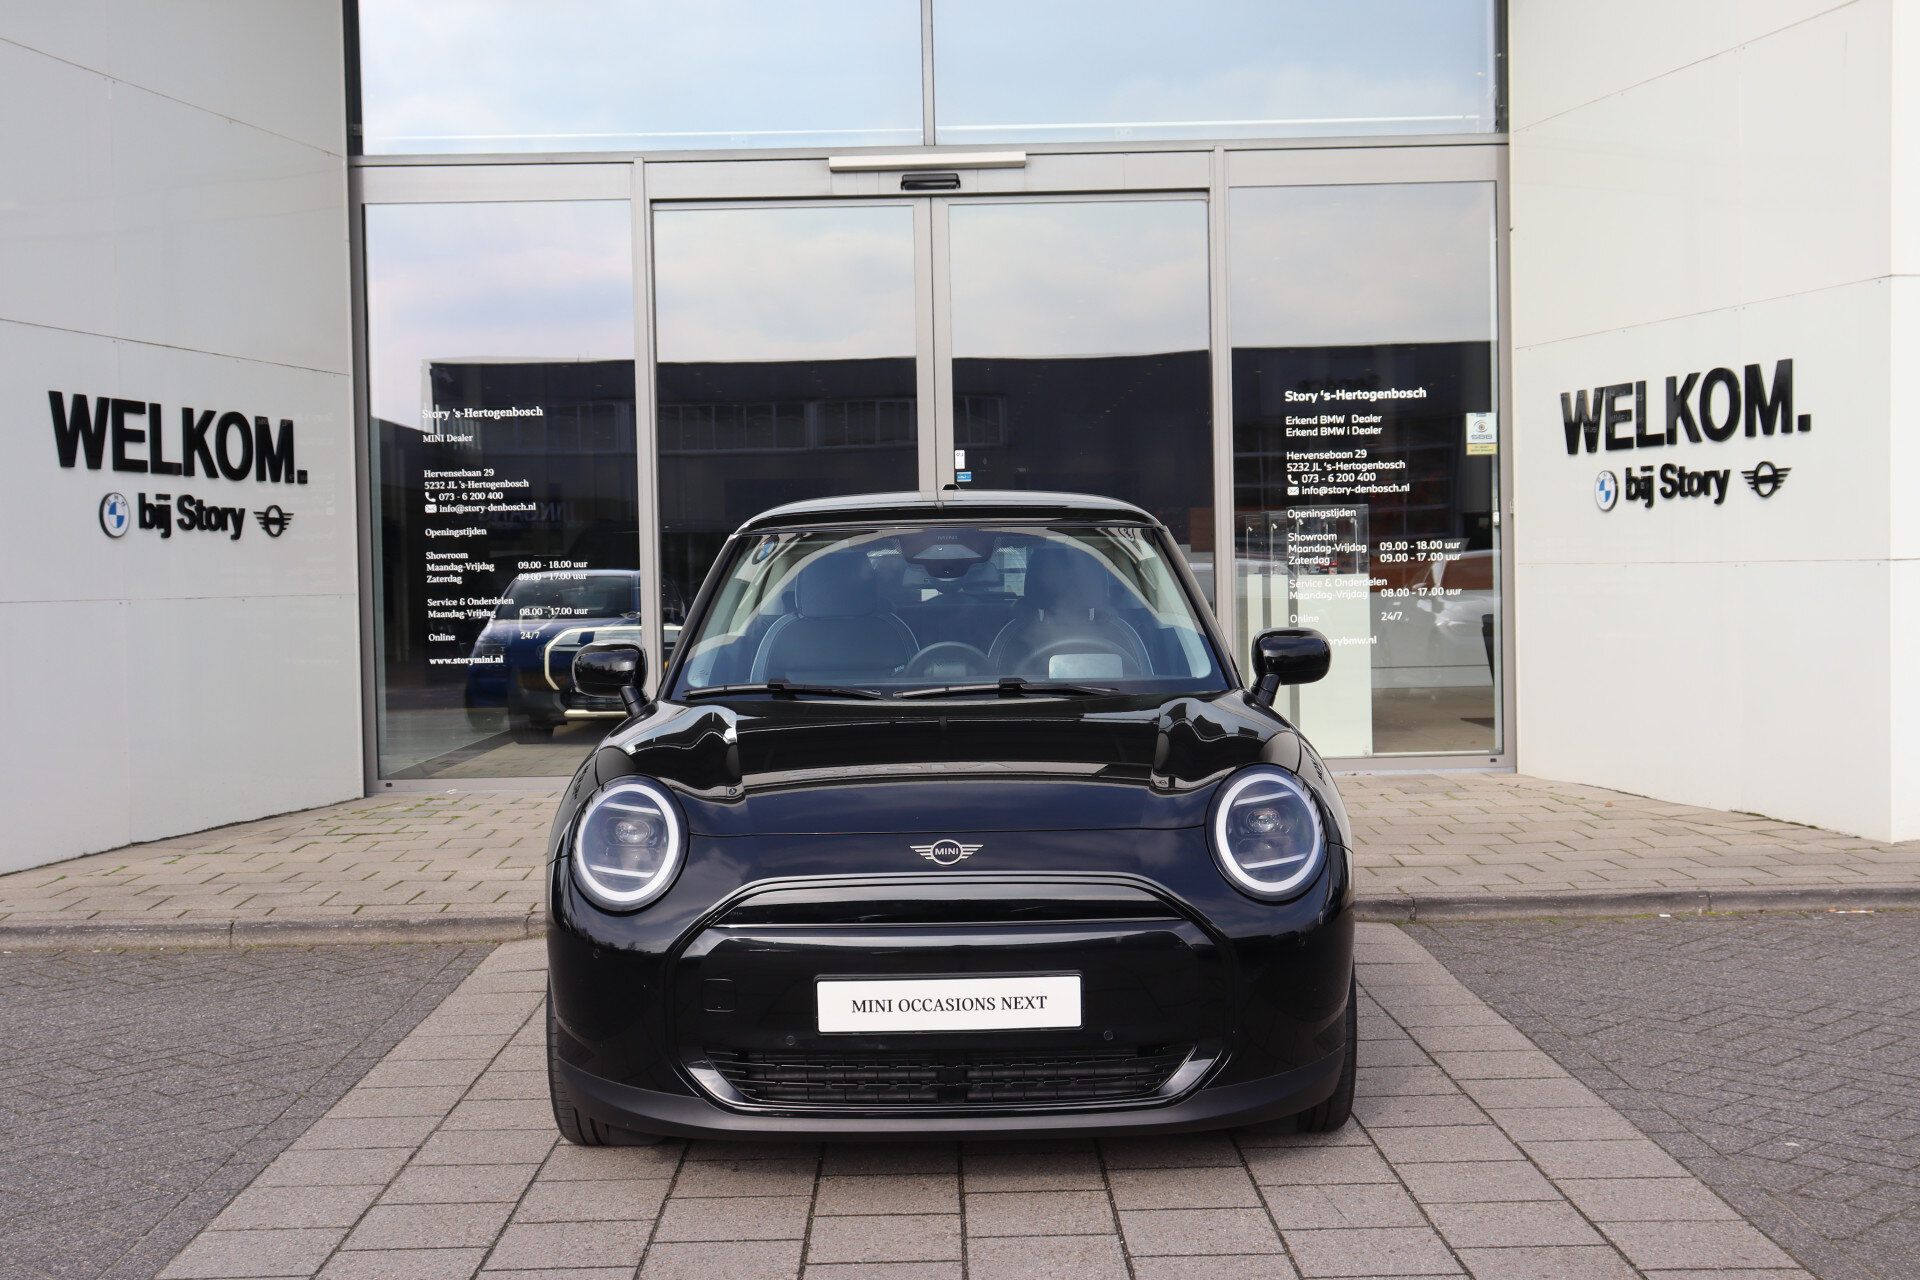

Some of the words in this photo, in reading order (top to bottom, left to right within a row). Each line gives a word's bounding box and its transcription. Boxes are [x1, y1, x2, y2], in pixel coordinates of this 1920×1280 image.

[1284, 390, 1318, 403] Story
[1560, 358, 1811, 455] WELKOM.
[422, 408, 450, 420] Story
[1285, 416, 1318, 425] Erkend
[1320, 415, 1345, 424] BMW
[1352, 414, 1382, 423] Dealer
[1286, 427, 1318, 437] Erkend
[1320, 426, 1345, 436] BMW
[1352, 426, 1382, 435] Dealer
[48, 390, 308, 484] WELKOM.
[422, 434, 444, 442] MINI
[446, 434, 473, 442] Dealer
[1286, 450, 1353, 460] Hervensebaan
[1354, 450, 1367, 459] 29
[1287, 462, 1310, 472] 5232
[1311, 462, 1322, 472] JL
[424, 469, 482, 478] Hervensebaan
[483, 469, 494, 477] 29
[1302, 474, 1319, 483] 073
[1328, 474, 1334, 482] 6
[1336, 473, 1355, 482] 200
[1357, 473, 1376, 482] 400
[424, 481, 445, 490] 5232
[446, 481, 457, 489] JL
[1302, 483, 1410, 496] info@story-denbosch.nl
[1625, 465, 1654, 509] bij
[1660, 463, 1731, 506] Story
[438, 492, 455, 501] 073
[462, 492, 468, 500] 6
[469, 492, 486, 500] 200
[487, 492, 503, 500] 400
[439, 502, 536, 514] info@story-denbosch.nl
[138, 492, 172, 539] bij
[177, 494, 245, 540] Story
[1287, 508, 1356, 520] Openingstijden
[425, 527, 487, 538] Openingstijden
[1288, 532, 1337, 542] Showroom
[1288, 543, 1367, 555] Maandag-Vrijdag
[1380, 542, 1408, 550] 09.00
[1416, 541, 1442, 550] 18.00
[1444, 541, 1460, 549] uur
[426, 552, 468, 560] Showroom
[1288, 556, 1330, 566] Zaterdag
[1380, 554, 1408, 562] 09.00
[1445, 553, 1461, 561] uur
[426, 562, 495, 573] Maandag-Vrijdag
[518, 561, 541, 569] 09.00
[549, 561, 571, 569] 18.00
[427, 575, 462, 585] Zaterdag
[518, 573, 541, 581] 09.00
[549, 573, 571, 581] 17.00
[1289, 579, 1322, 588] Service
[1325, 578, 1332, 587] &
[1334, 577, 1388, 587] Onderdelen
[1289, 589, 1368, 601] Maandag-Vrijdag
[1380, 588, 1409, 597] 08.00
[1446, 588, 1462, 596] uur
[427, 598, 458, 607] Service
[459, 598, 466, 606] &
[468, 597, 514, 605] Onderdelen
[428, 609, 496, 620] Maandag-Vrijdag
[519, 608, 543, 616] 08.00
[551, 608, 572, 616] 17.00
[1380, 612, 1402, 621] 24/7
[1290, 614, 1320, 623] Online
[428, 633, 456, 641] Online
[520, 632, 540, 640] 24/7
[1328, 635, 1377, 646] orybmw.nl
[429, 655, 504, 666] www.storymini.nl
[851, 999, 892, 1013] MINI
[898, 997, 996, 1012] OCCASIONS
[1001, 995, 1047, 1010] NEXT
